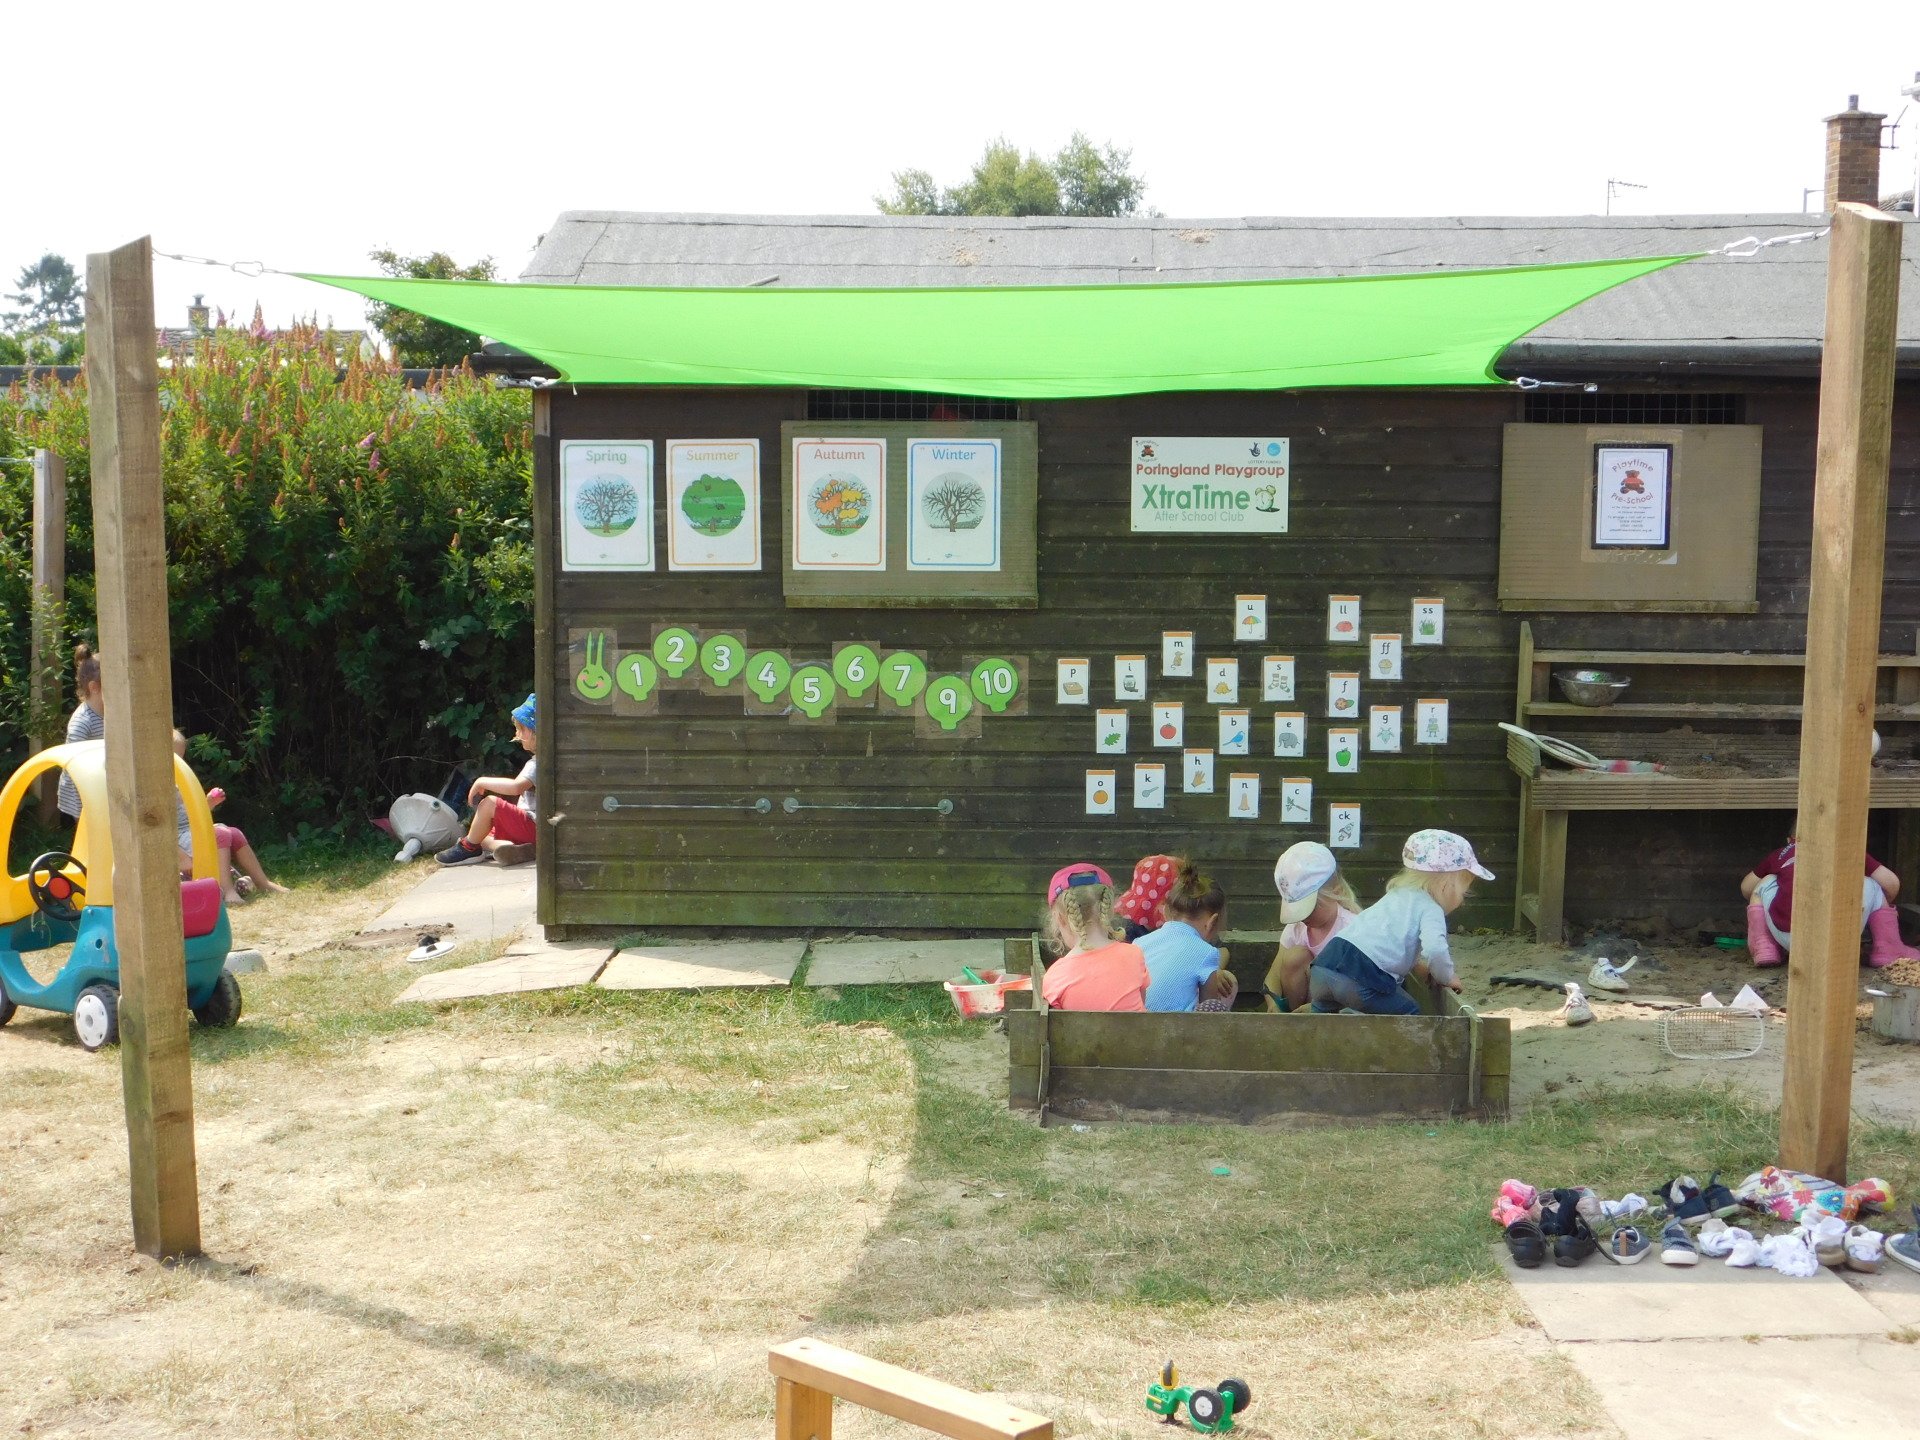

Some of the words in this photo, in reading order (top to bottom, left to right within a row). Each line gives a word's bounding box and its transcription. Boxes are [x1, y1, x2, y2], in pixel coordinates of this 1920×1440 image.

[585, 449, 627, 464] Spring
[686, 449, 740, 461] Summer
[813, 448, 865, 460] Autumn
[932, 448, 976, 460] Winter
[1136, 464, 1210, 478] Poringland
[1215, 464, 1285, 478] Playgroup
[1612, 459, 1654, 472] Playtime
[1141, 484, 1250, 510] XtraTime
[1154, 511, 1178, 522] After
[1181, 511, 1217, 522] School
[1220, 511, 1244, 522] Club
[666, 636, 685, 663] 2
[1174, 640, 1184, 648] m
[1380, 642, 1391, 655] ff
[712, 645, 732, 672] 3
[629, 661, 643, 687] 1
[757, 662, 777, 688] 4
[846, 656, 866, 682] 6
[1070, 668, 1076, 678] p
[1219, 668, 1226, 677] d
[893, 665, 912, 691] 7
[978, 667, 1012, 696] 10
[802, 677, 821, 704] 5
[1341, 681, 1348, 694] f
[939, 688, 957, 714] 9
[1231, 717, 1237, 726] b
[1382, 714, 1389, 724] g
[1194, 756, 1201, 765] h
[1145, 773, 1152, 783] k
[1241, 781, 1248, 789] n
[1338, 811, 1351, 820] ck
